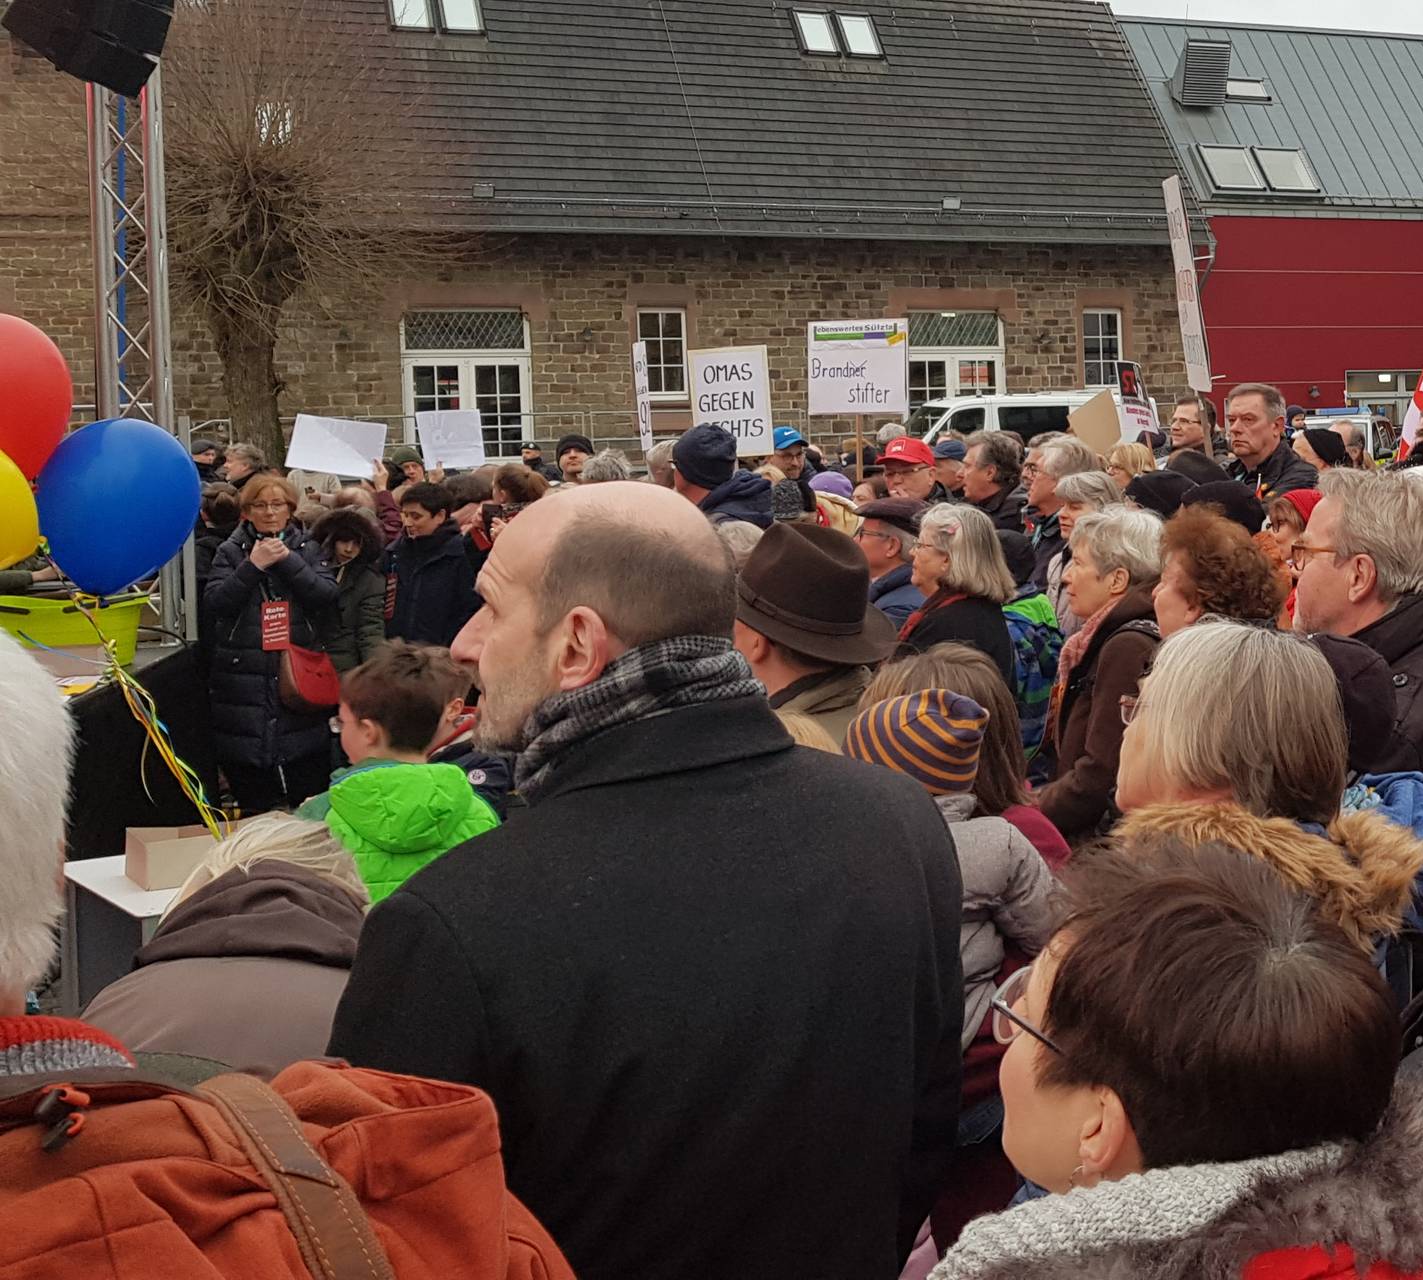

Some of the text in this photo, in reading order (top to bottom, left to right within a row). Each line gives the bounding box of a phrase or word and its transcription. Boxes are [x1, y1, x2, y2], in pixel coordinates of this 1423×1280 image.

[703, 363, 753, 384] OMAS
[699, 391, 755, 413] GEGEN
[847, 382, 890, 404] stifter
[703, 418, 763, 438] CHTS
